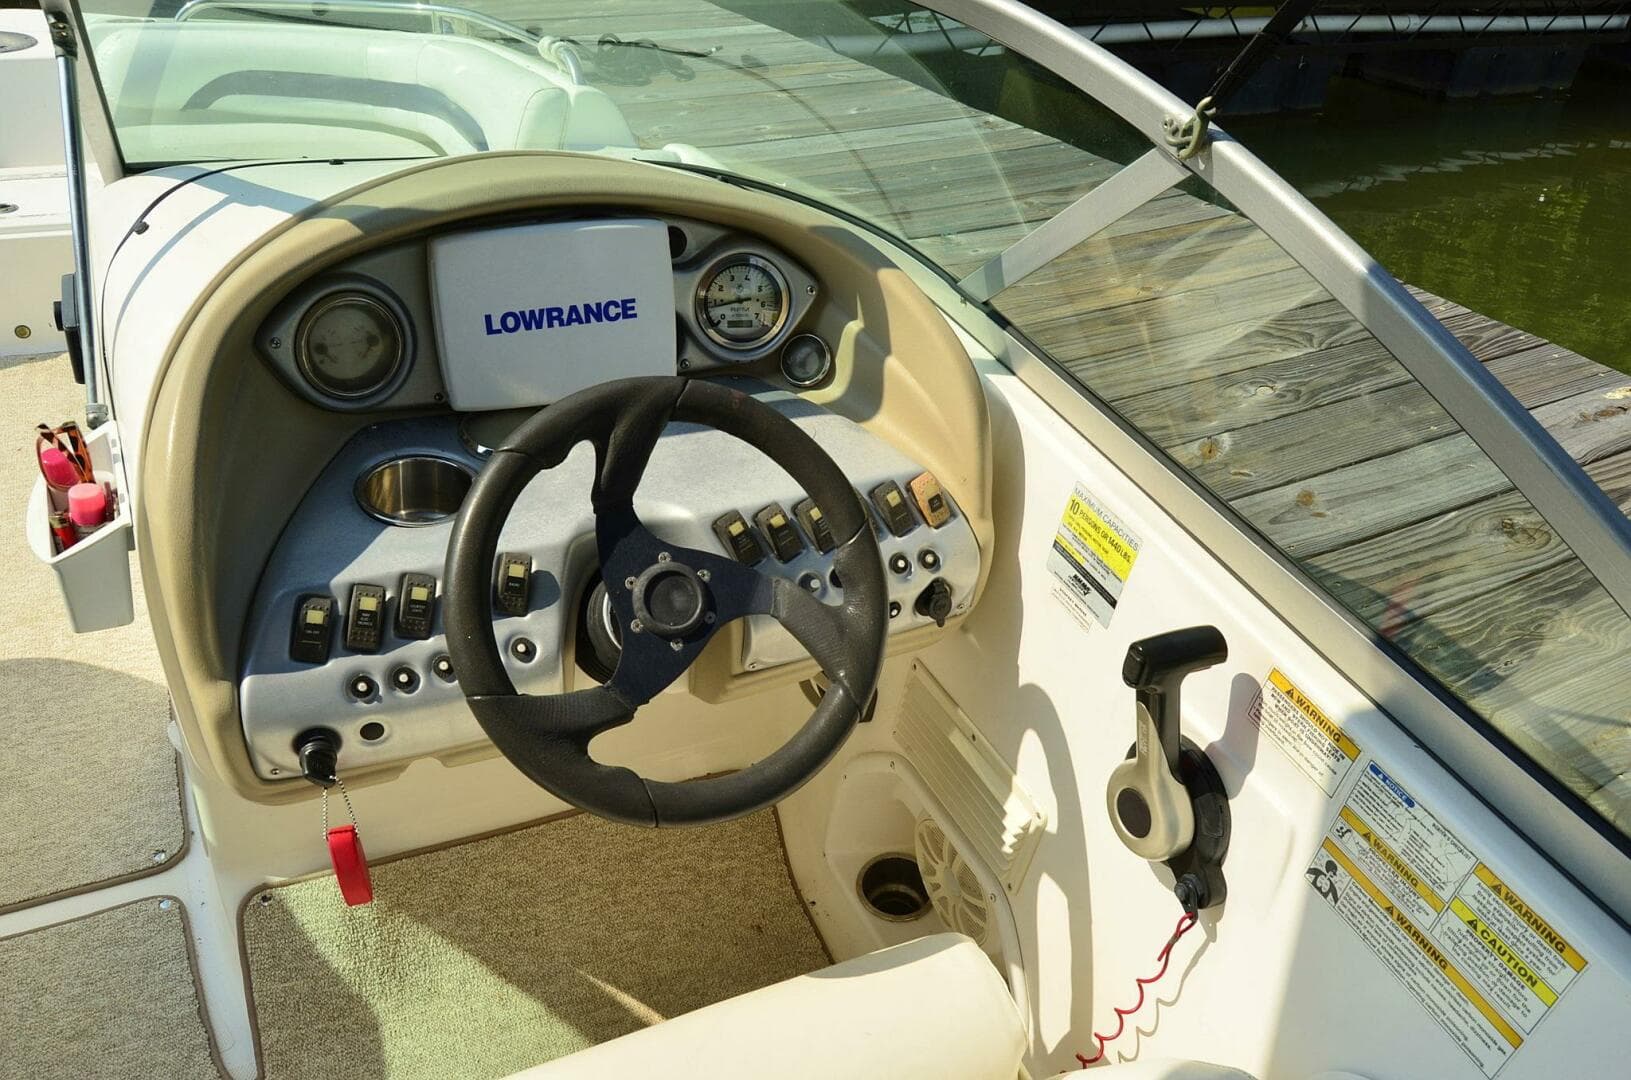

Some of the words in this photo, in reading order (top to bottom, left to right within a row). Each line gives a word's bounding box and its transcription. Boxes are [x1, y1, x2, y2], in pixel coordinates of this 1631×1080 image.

[484, 298, 637, 335] LOWRANCE
[1068, 497, 1080, 516] 10
[1078, 508, 1101, 534] PERSONS
[1100, 528, 1109, 541] OR
[1074, 487, 1102, 517] MAXIMUM
[1101, 513, 1139, 551] CAPACITIES
[1294, 695, 1342, 743] WARNING
[1385, 778, 1407, 801] NOTICE
[1371, 838, 1419, 888] WARNING
[1394, 913, 1448, 970] WARNING
[1502, 891, 1567, 954] WARNING
[1464, 929, 1497, 962] PROPERTY
[1497, 961, 1526, 990] DAMAGE
[1478, 927, 1538, 988] CAUTION
